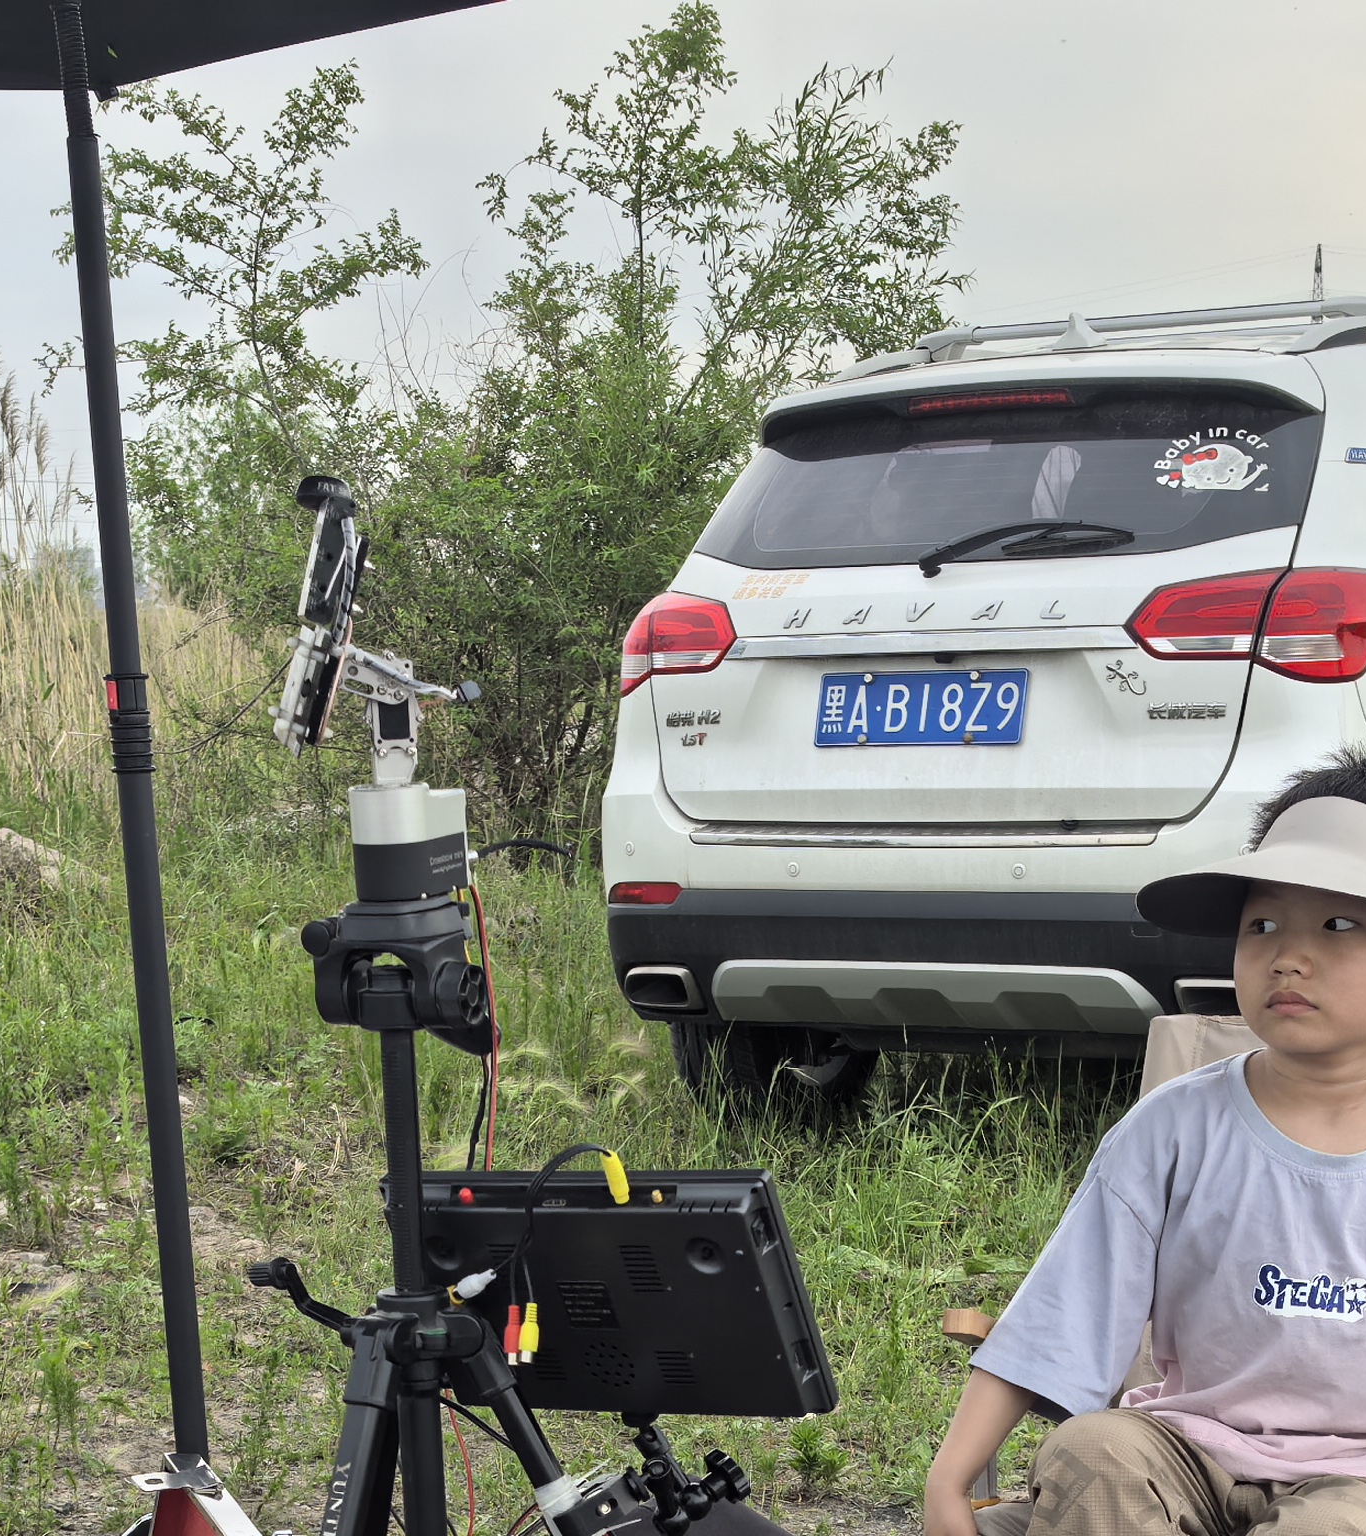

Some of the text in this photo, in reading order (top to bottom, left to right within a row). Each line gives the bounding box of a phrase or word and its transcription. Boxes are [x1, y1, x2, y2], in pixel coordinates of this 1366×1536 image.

[1153, 426, 1270, 470] Baby in car
[782, 600, 1067, 629] HAVAL
[697, 709, 721, 726] H2
[1147, 701, 1227, 720] 长城汽车
